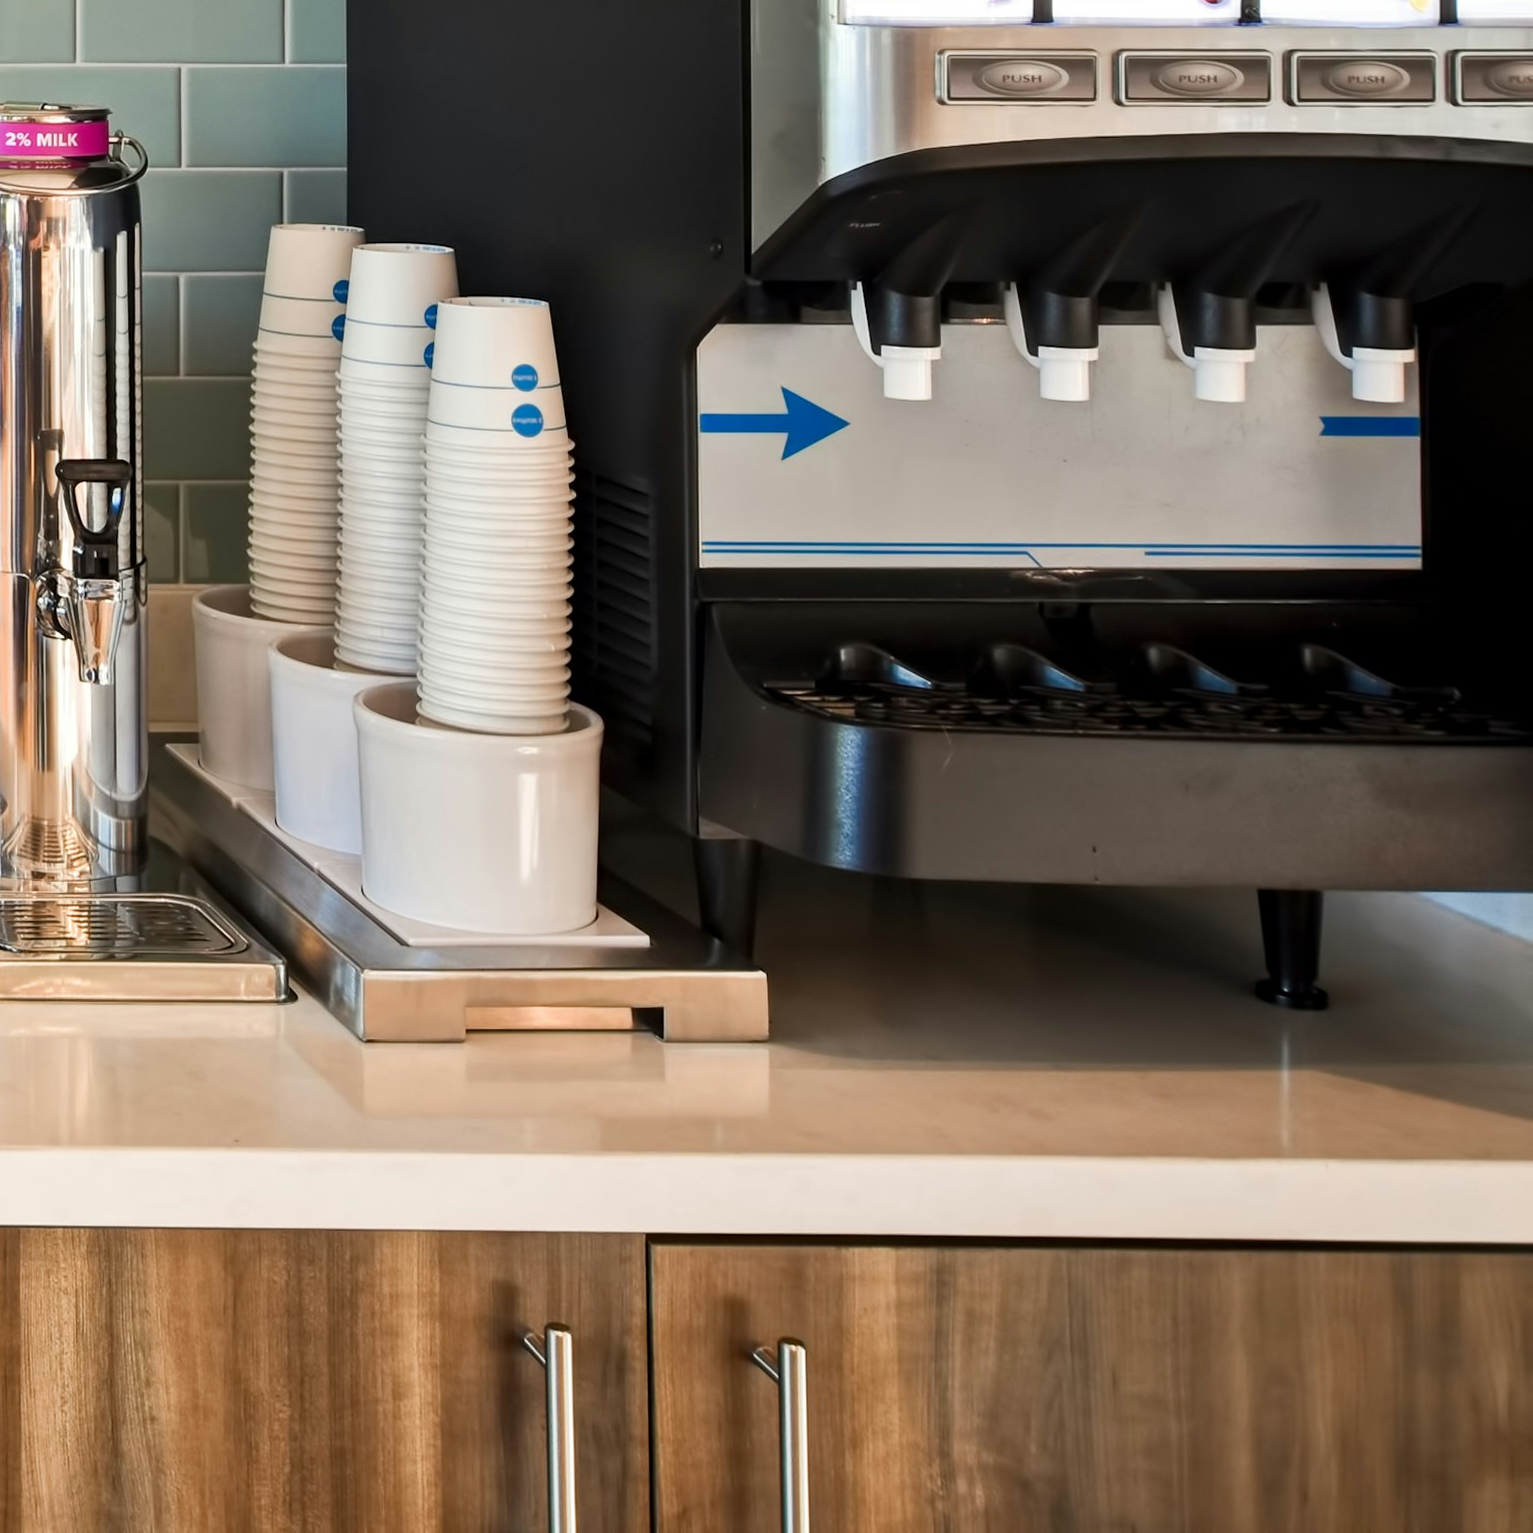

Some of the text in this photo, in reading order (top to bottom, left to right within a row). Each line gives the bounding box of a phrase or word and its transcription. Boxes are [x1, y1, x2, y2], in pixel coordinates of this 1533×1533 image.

[1002, 74, 1042, 84] PUSH
[1178, 74, 1218, 84] PUSH
[1347, 75, 1385, 84] PUSH
[1508, 75, 1533, 84] PUS
[5, 132, 78, 147] 2% MILK
